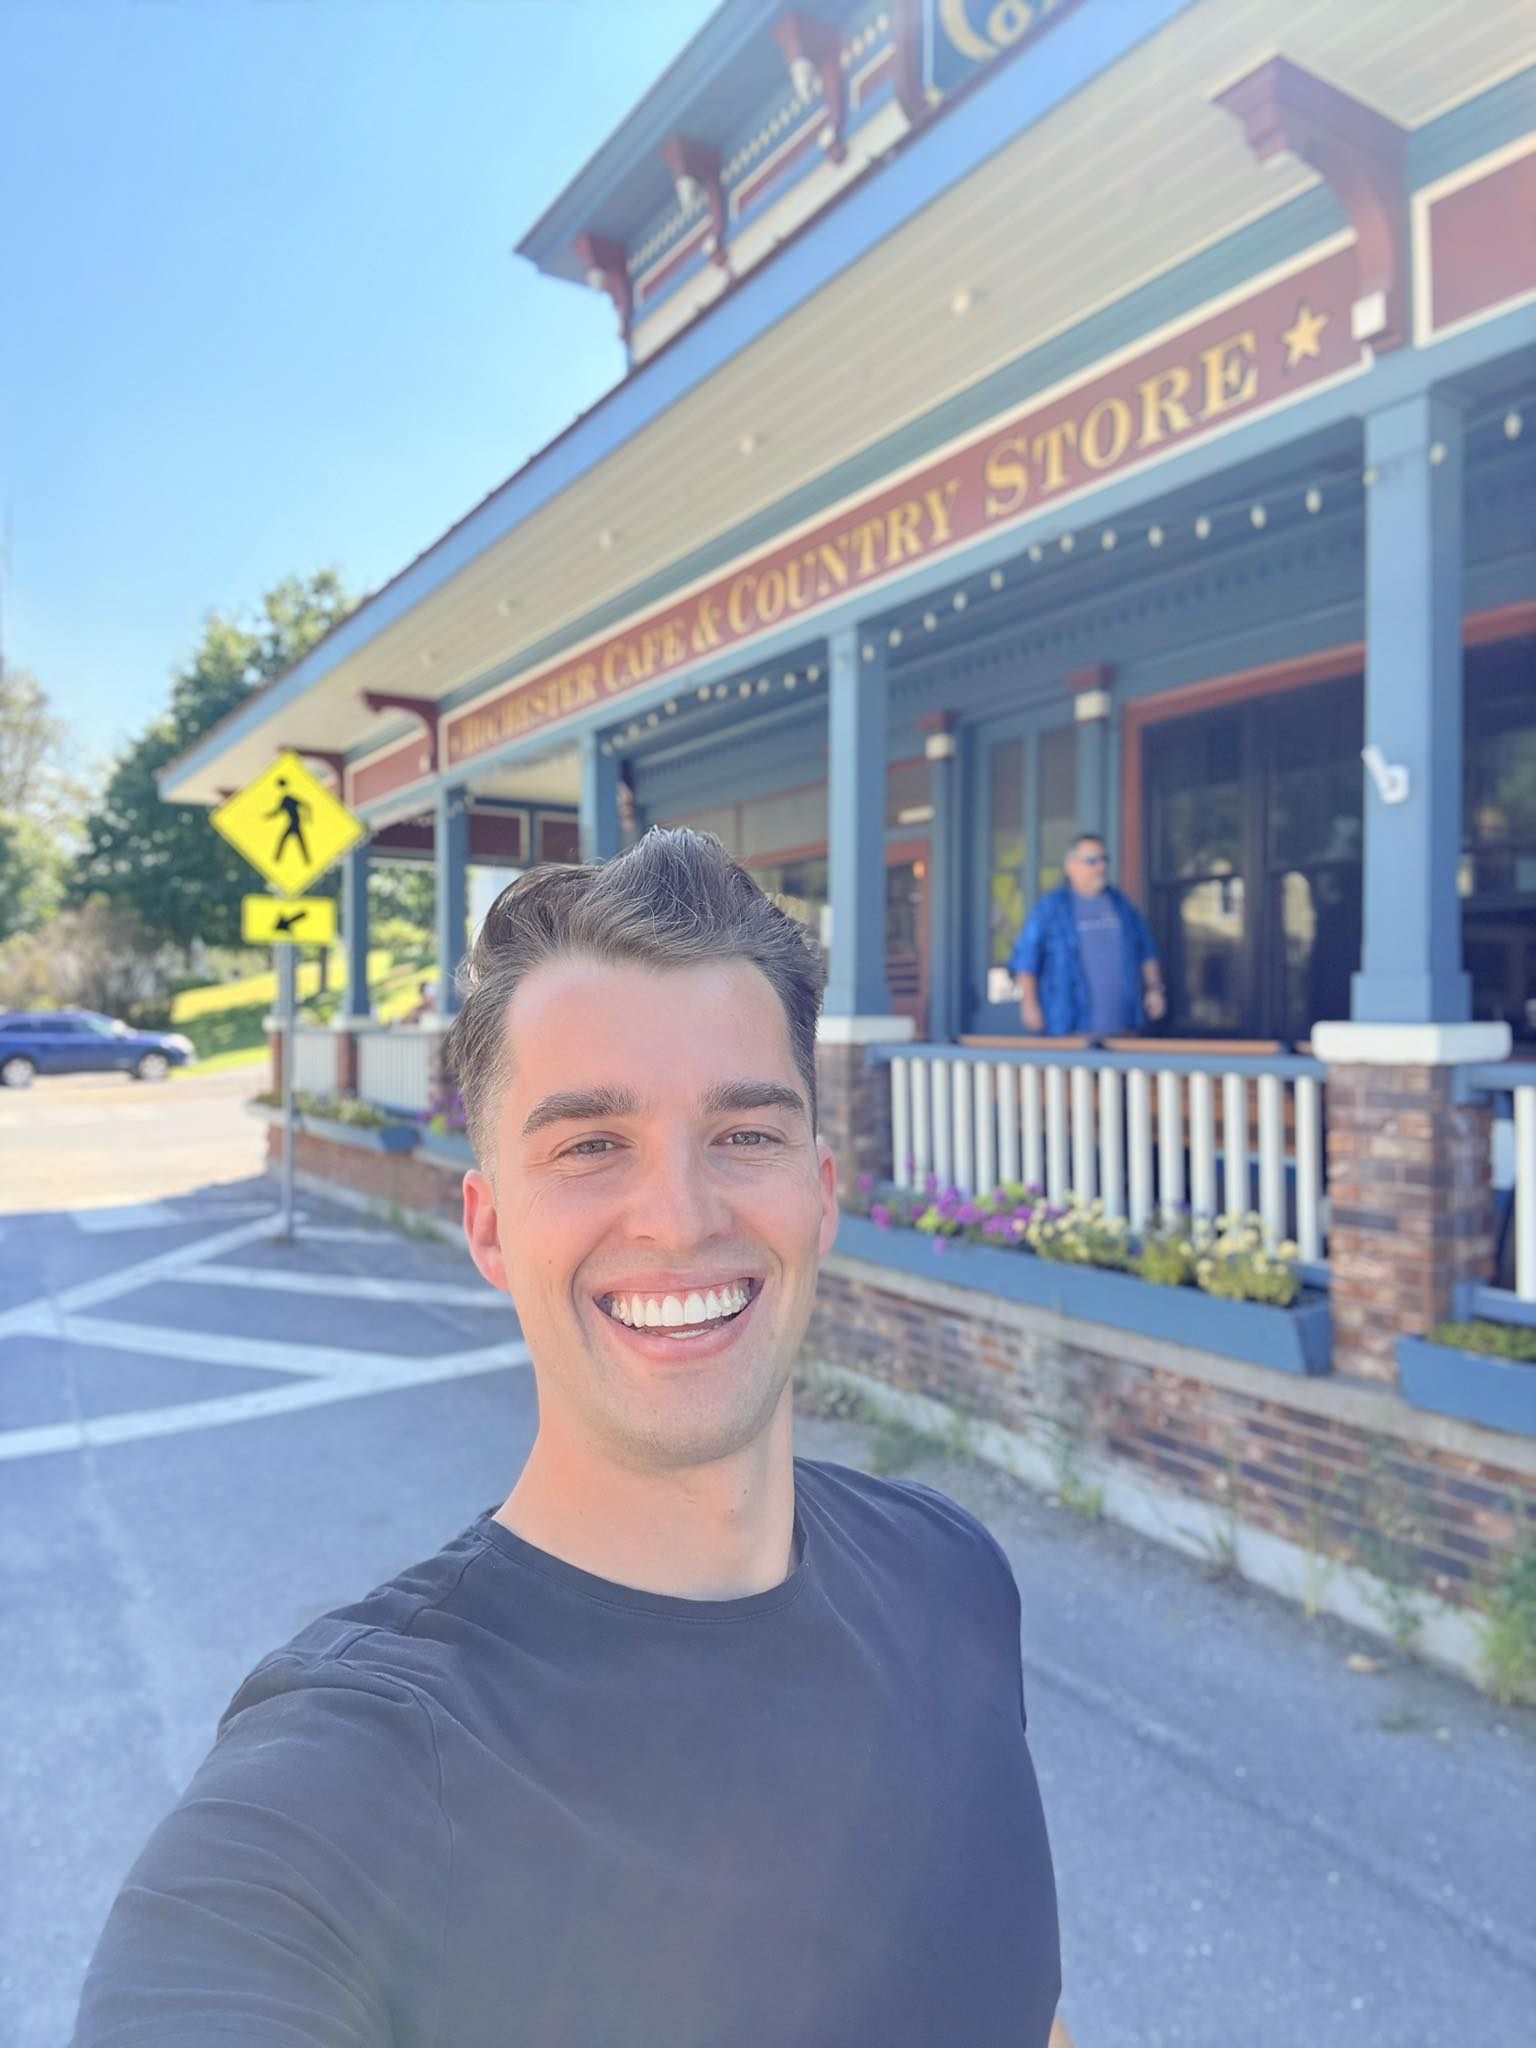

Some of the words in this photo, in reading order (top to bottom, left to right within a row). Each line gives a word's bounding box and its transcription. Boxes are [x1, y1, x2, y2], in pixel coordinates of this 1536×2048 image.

[691, 594, 722, 652] &
[728, 478, 961, 635] COUNTRY
[985, 330, 1260, 520] STORE
